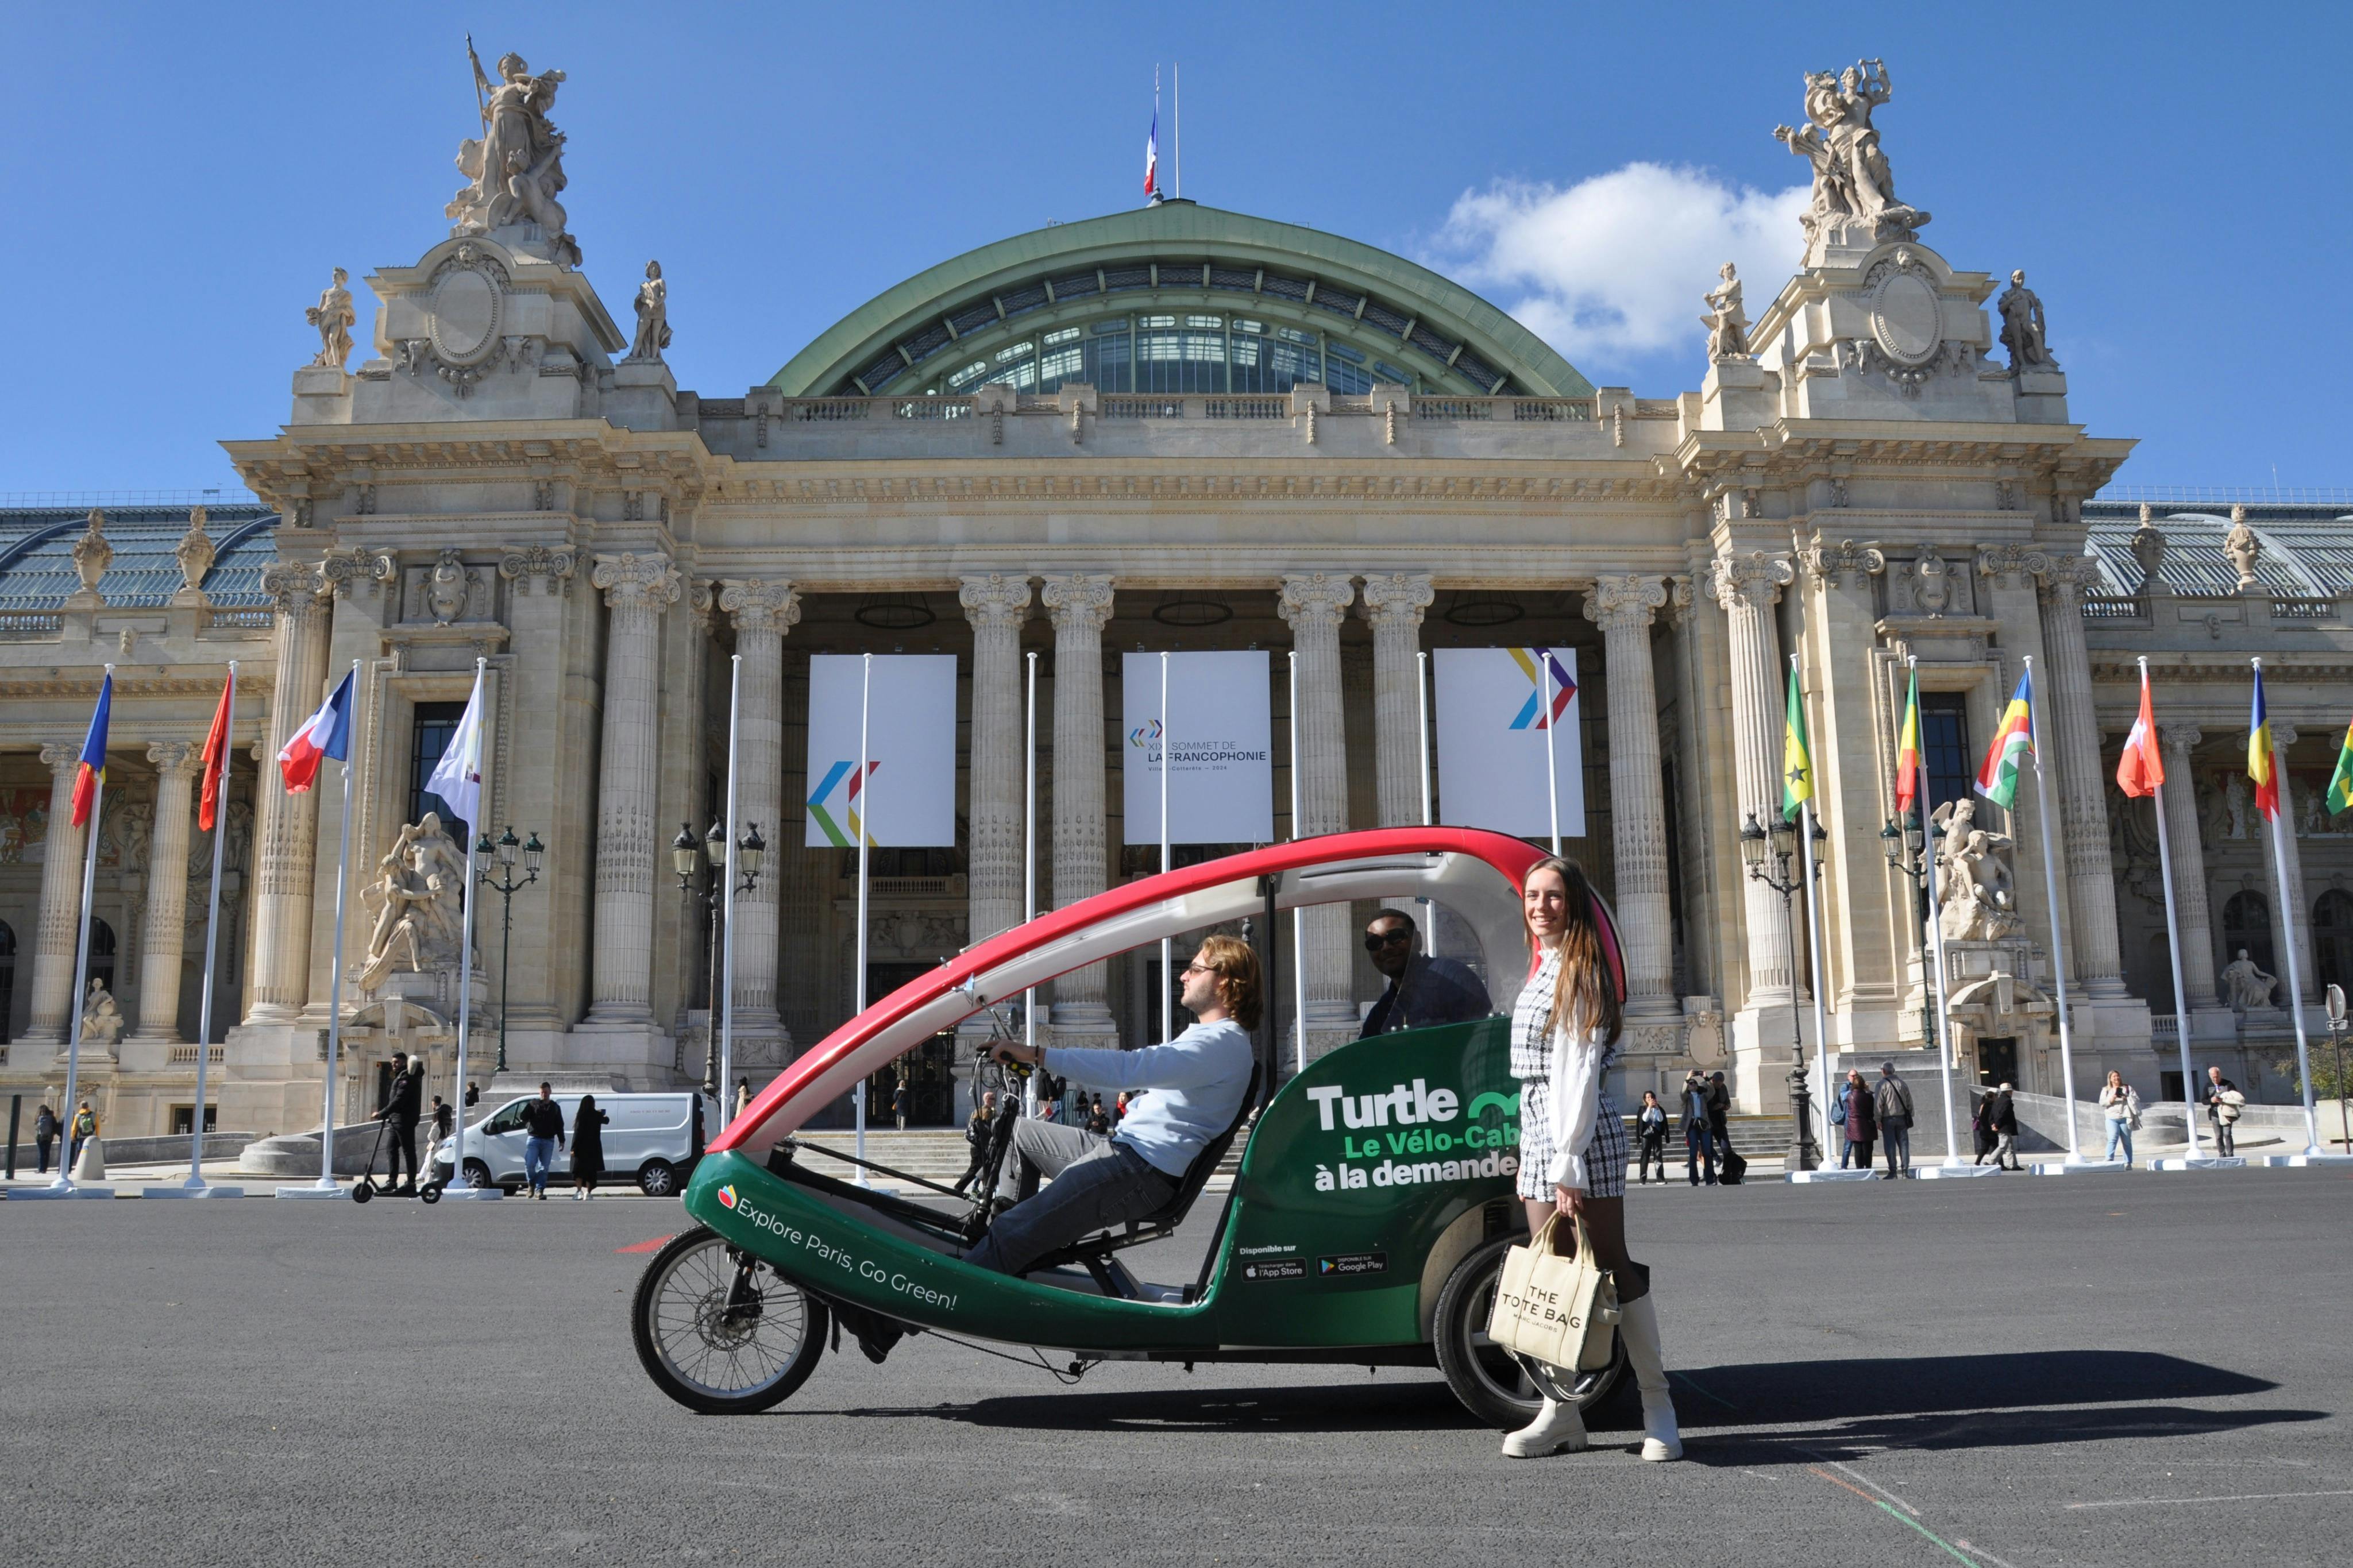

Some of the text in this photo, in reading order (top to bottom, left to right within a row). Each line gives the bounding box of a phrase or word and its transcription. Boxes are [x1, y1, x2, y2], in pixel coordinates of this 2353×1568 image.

[1171, 741, 1219, 751] SOMMET
[1222, 741, 1236, 750] DE
[1148, 753, 1163, 762] LA
[1307, 1078, 1459, 1131] Turtle
[1345, 1122, 1520, 1158] Le Vélo-Cab
[1315, 1150, 1518, 1191] à la demande
[736, 1197, 958, 1311] Explore Paris, Go Green!
[1240, 1245, 1282, 1256] Disponible
[1259, 1267, 1302, 1277] l'App Store
[1338, 1261, 1383, 1272] Google Play
[1530, 1285, 1559, 1305] THE
[1503, 1293, 1581, 1329] TOTE BAG
[1513, 1313, 1558, 1333] MARC JACOBS
